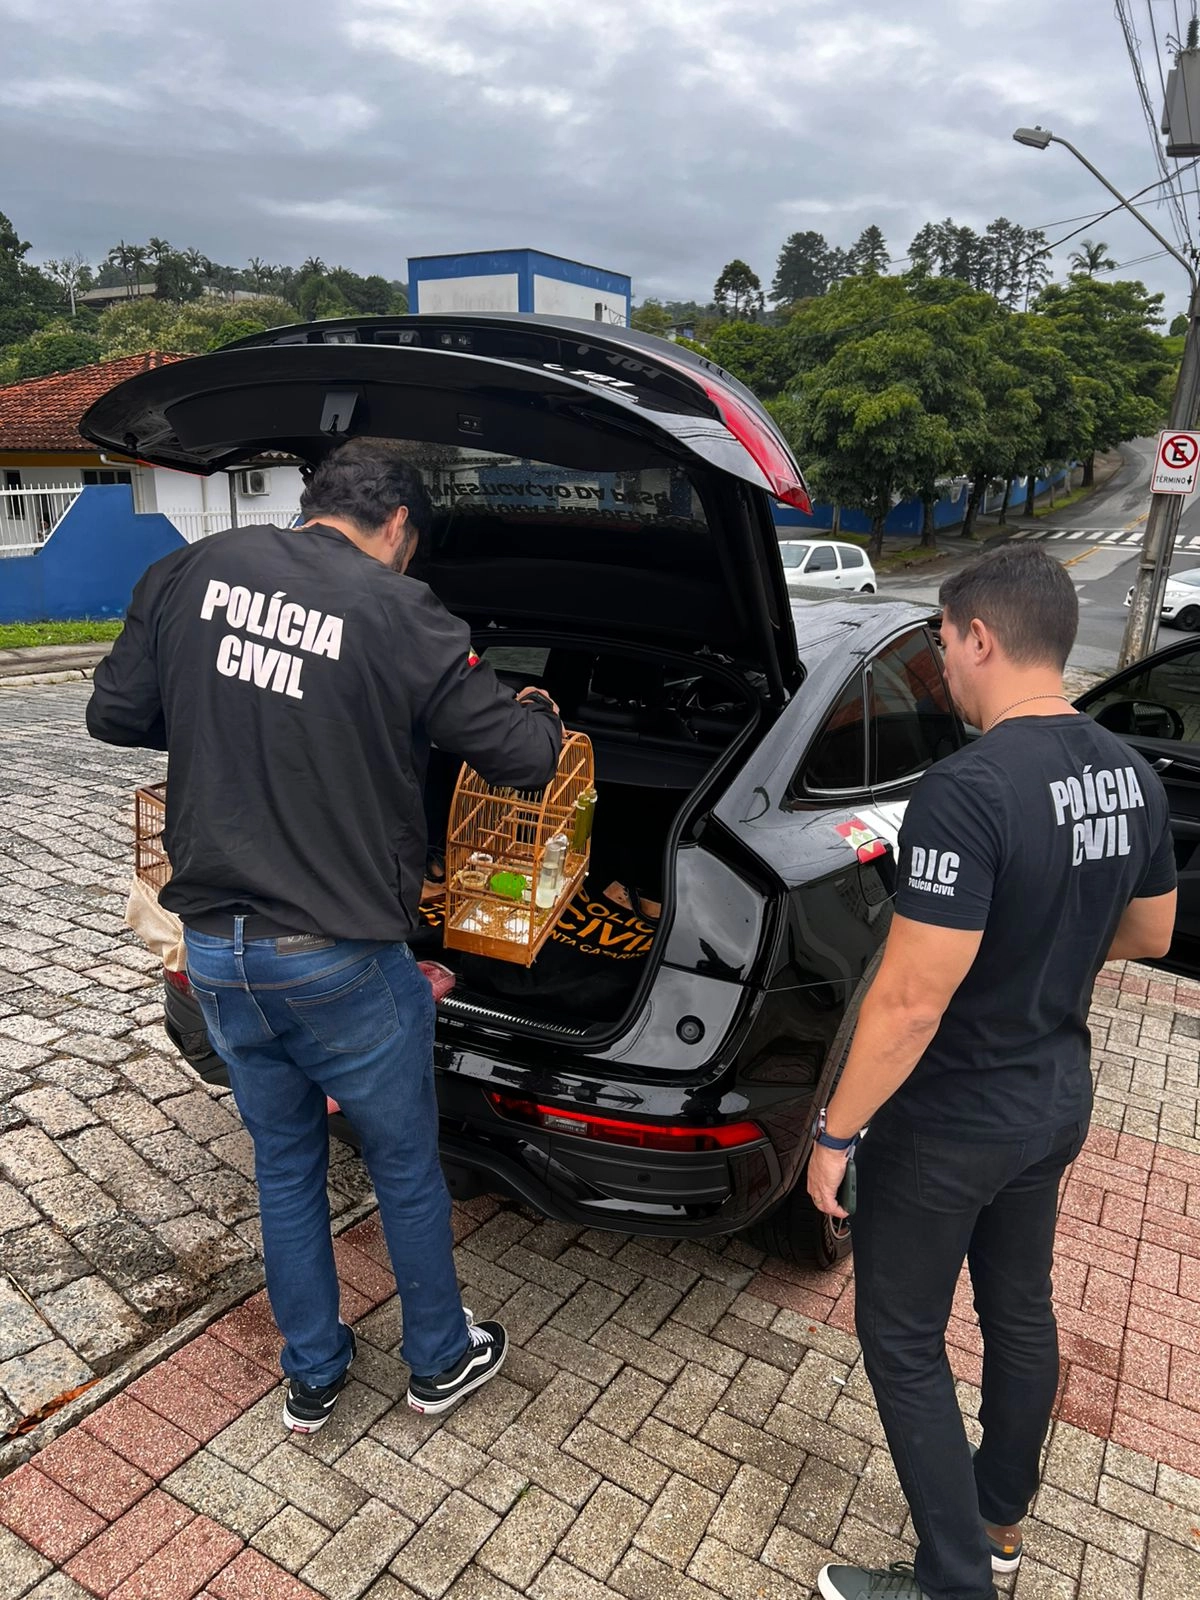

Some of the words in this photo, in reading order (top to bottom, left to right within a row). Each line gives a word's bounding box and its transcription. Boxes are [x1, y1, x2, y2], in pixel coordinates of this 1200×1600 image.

[200, 579, 344, 661] POLÍCIA
[216, 634, 304, 699] CIVIL
[1049, 765, 1145, 826] POÍCIA
[911, 846, 960, 884] DIC
[1072, 814, 1131, 867] CVIL
[908, 877, 932, 892] POLÍCIA
[932, 883, 955, 897] CIVIL
